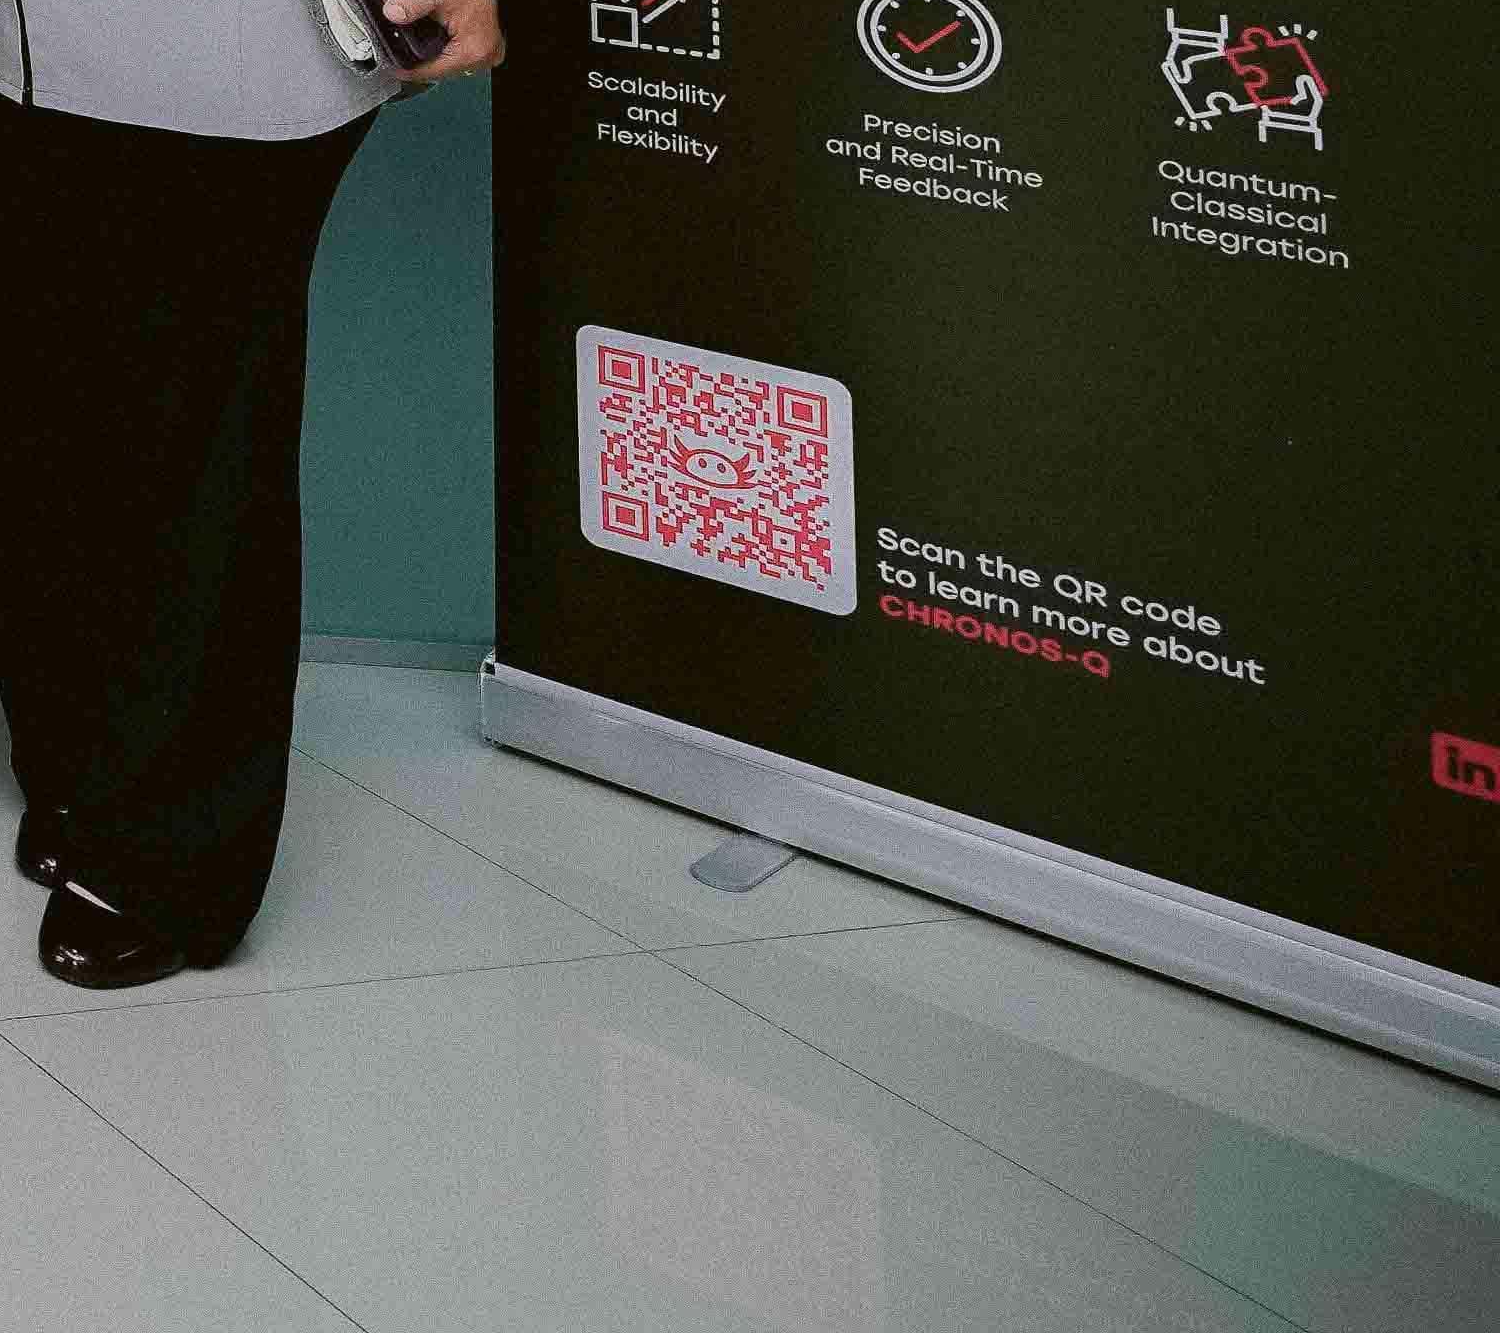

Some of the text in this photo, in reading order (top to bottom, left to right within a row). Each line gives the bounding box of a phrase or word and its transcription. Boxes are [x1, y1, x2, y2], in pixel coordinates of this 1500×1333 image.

[588, 72, 726, 112] Scalability
[627, 102, 677, 127] and
[598, 123, 718, 164] Flexibility
[863, 113, 1001, 154] Precision
[825, 135, 1044, 187] and Real-Time
[1157, 159, 1338, 205] Quantum-
[860, 165, 1009, 211] Feedback
[1169, 191, 1328, 236] Classical
[1152, 215, 1350, 270] Integration
[877, 528, 1222, 637] Scan the QR code
[877, 561, 1265, 685] to learn more about
[879, 592, 1110, 678] CHRONOS-Q
[1446, 747, 1495, 791] in
